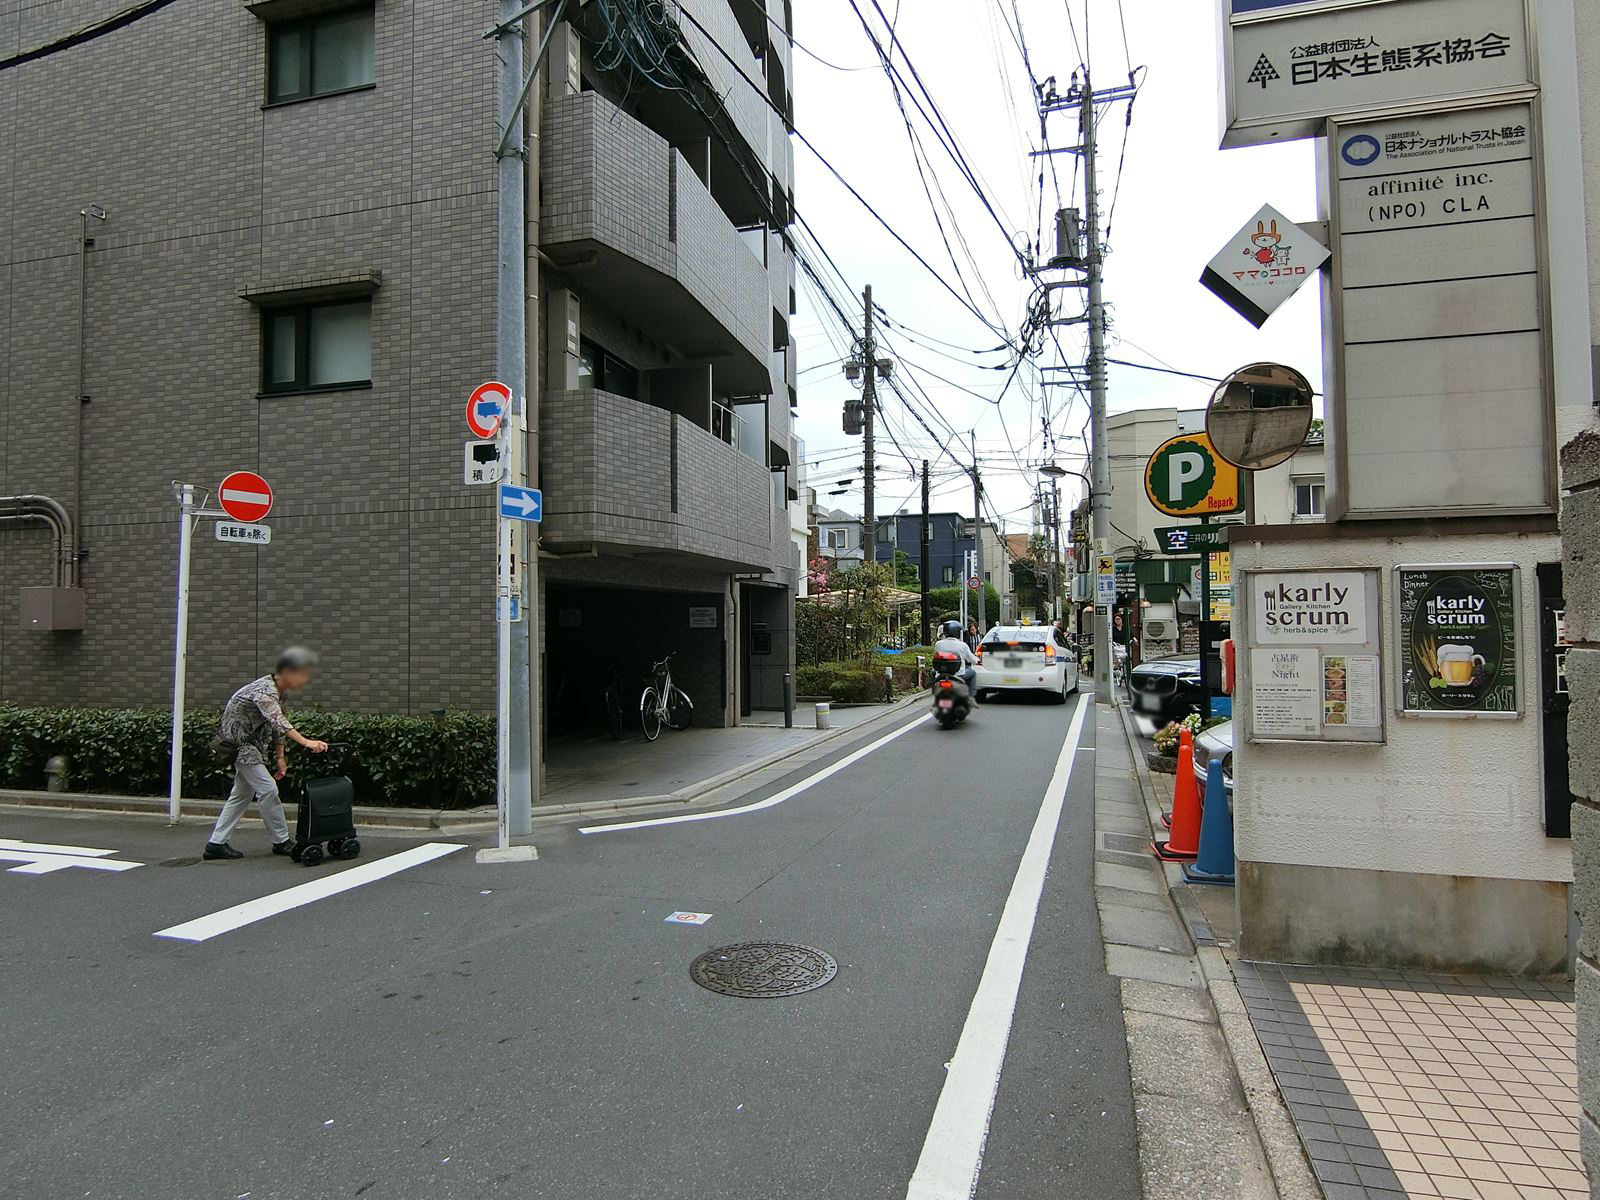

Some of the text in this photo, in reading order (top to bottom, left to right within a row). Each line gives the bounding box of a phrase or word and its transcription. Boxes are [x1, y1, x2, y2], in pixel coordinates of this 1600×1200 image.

[1290, 35, 1381, 59] 公益財団法人
[1291, 32, 1511, 86] 日本生態系協会
[1385, 125, 1526, 153] 日本ナショナル・トラスト協会
[1386, 152, 1399, 160] The
[1399, 148, 1438, 159] Association
[1446, 144, 1475, 153] National
[1475, 141, 1496, 150] Trusts
[1504, 138, 1526, 148] Japan
[1368, 171, 1494, 197] affinité inc.
[1368, 201, 1426, 223] (NPO)
[472, 469, 484, 482] 積
[1168, 450, 1205, 502] P
[1208, 496, 1234, 510] Repark
[220, 526, 266, 541] 自転車を除く
[1167, 529, 1189, 550] 空
[1279, 582, 1349, 606] karly
[1404, 581, 1430, 589] Dinner
[1436, 595, 1485, 612] karly
[1265, 611, 1349, 626] scrum
[1427, 613, 1486, 625] scrum
[1283, 626, 1329, 635] herb&spice
[1271, 670, 1300, 680] Night
